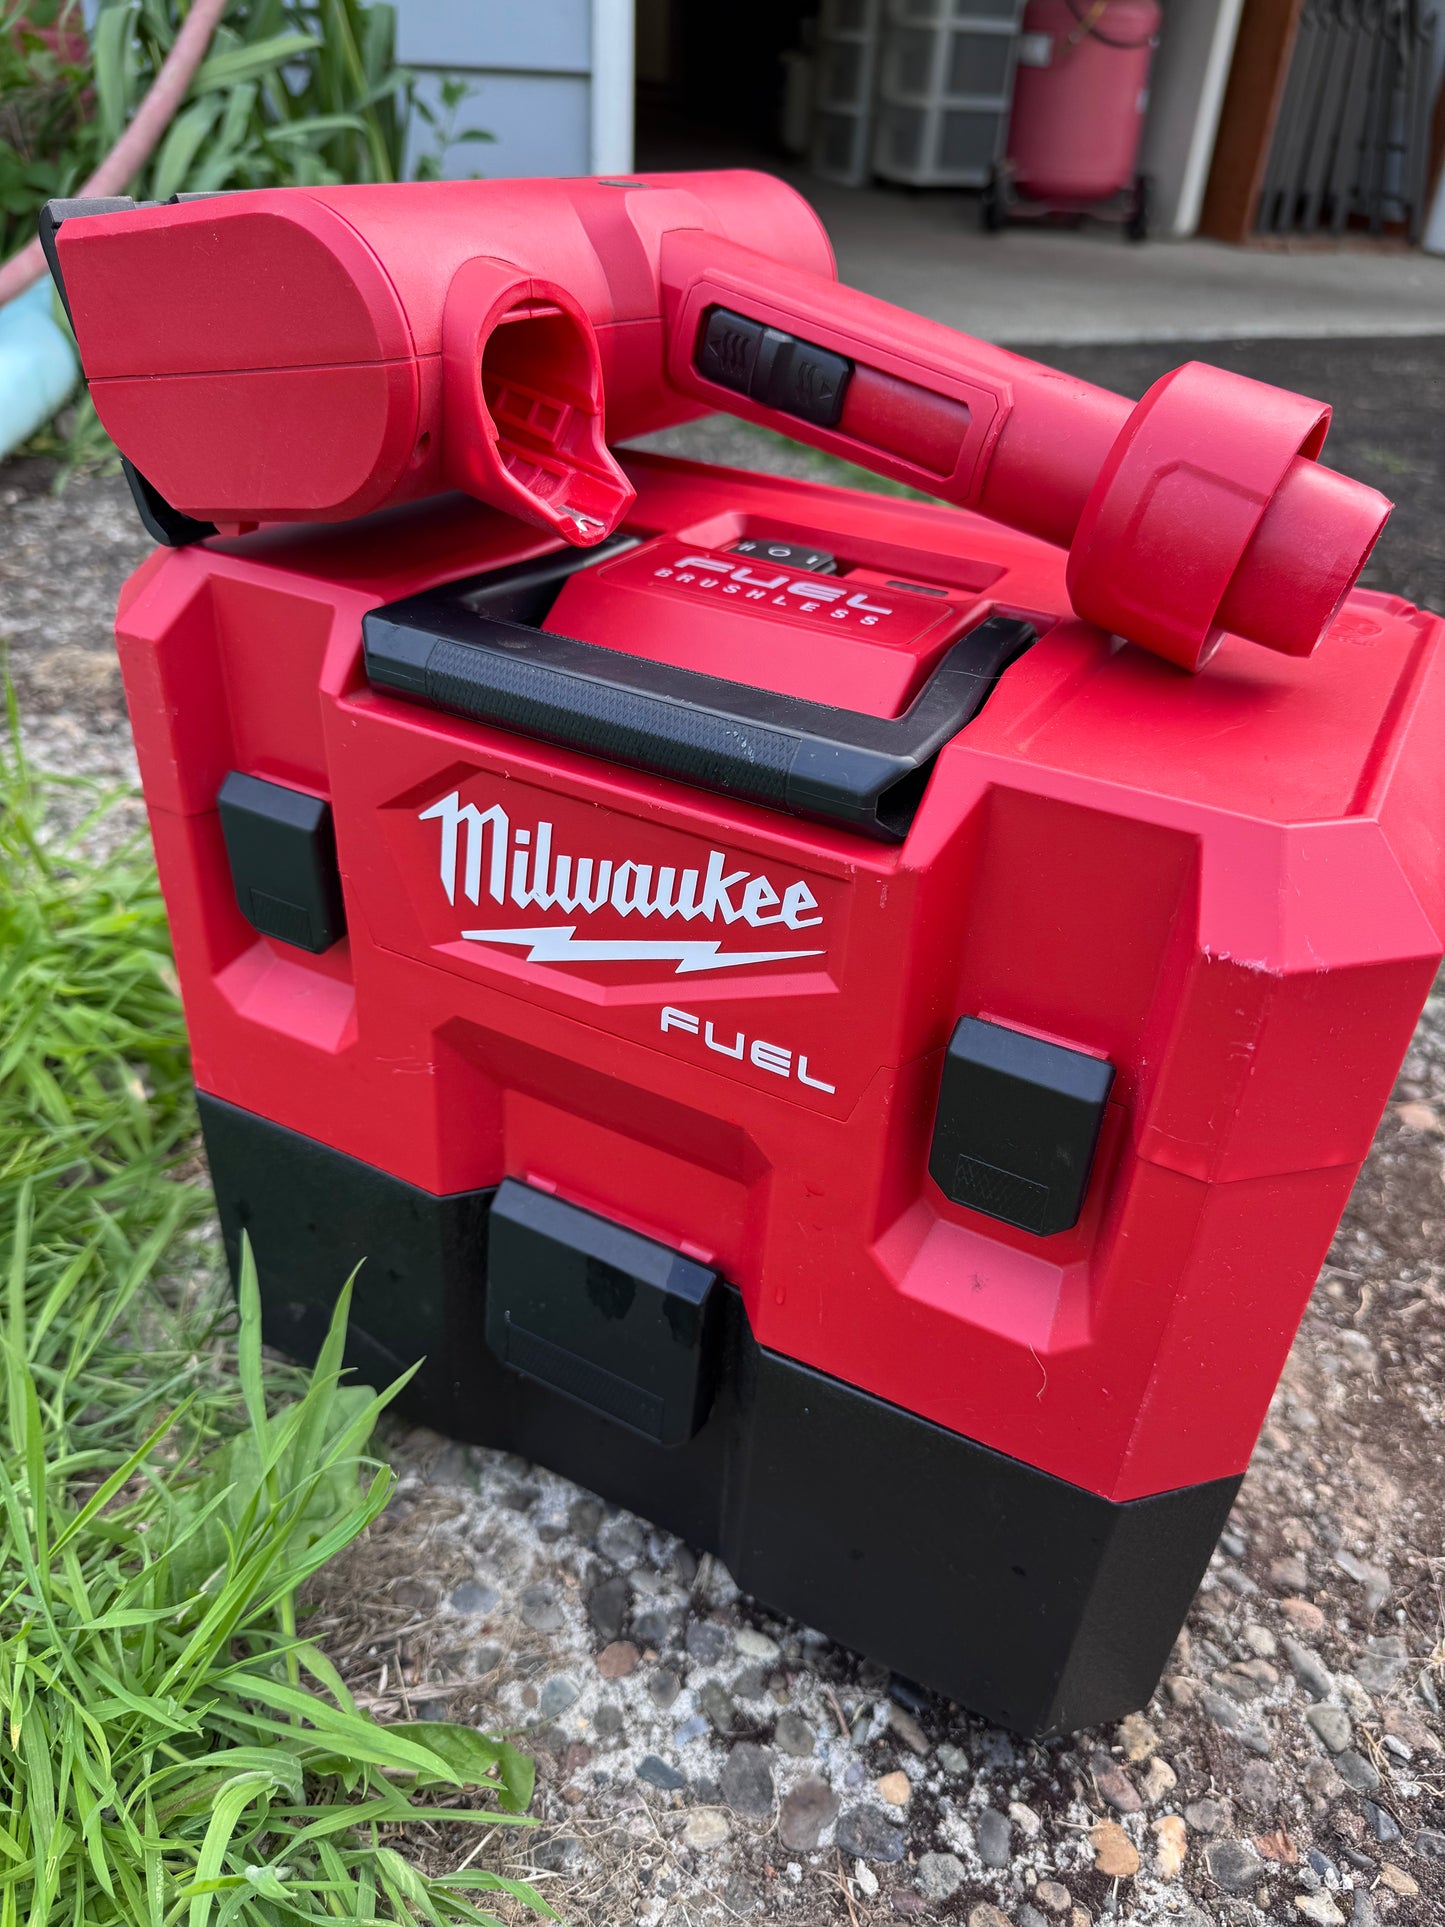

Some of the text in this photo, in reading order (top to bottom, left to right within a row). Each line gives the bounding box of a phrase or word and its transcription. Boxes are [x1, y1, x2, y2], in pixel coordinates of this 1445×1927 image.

[654, 568, 879, 625] BRUSHLESS
[674, 556, 892, 615] FUEL
[419, 791, 823, 930] Milwaukee
[661, 1006, 836, 1094] FUEL
